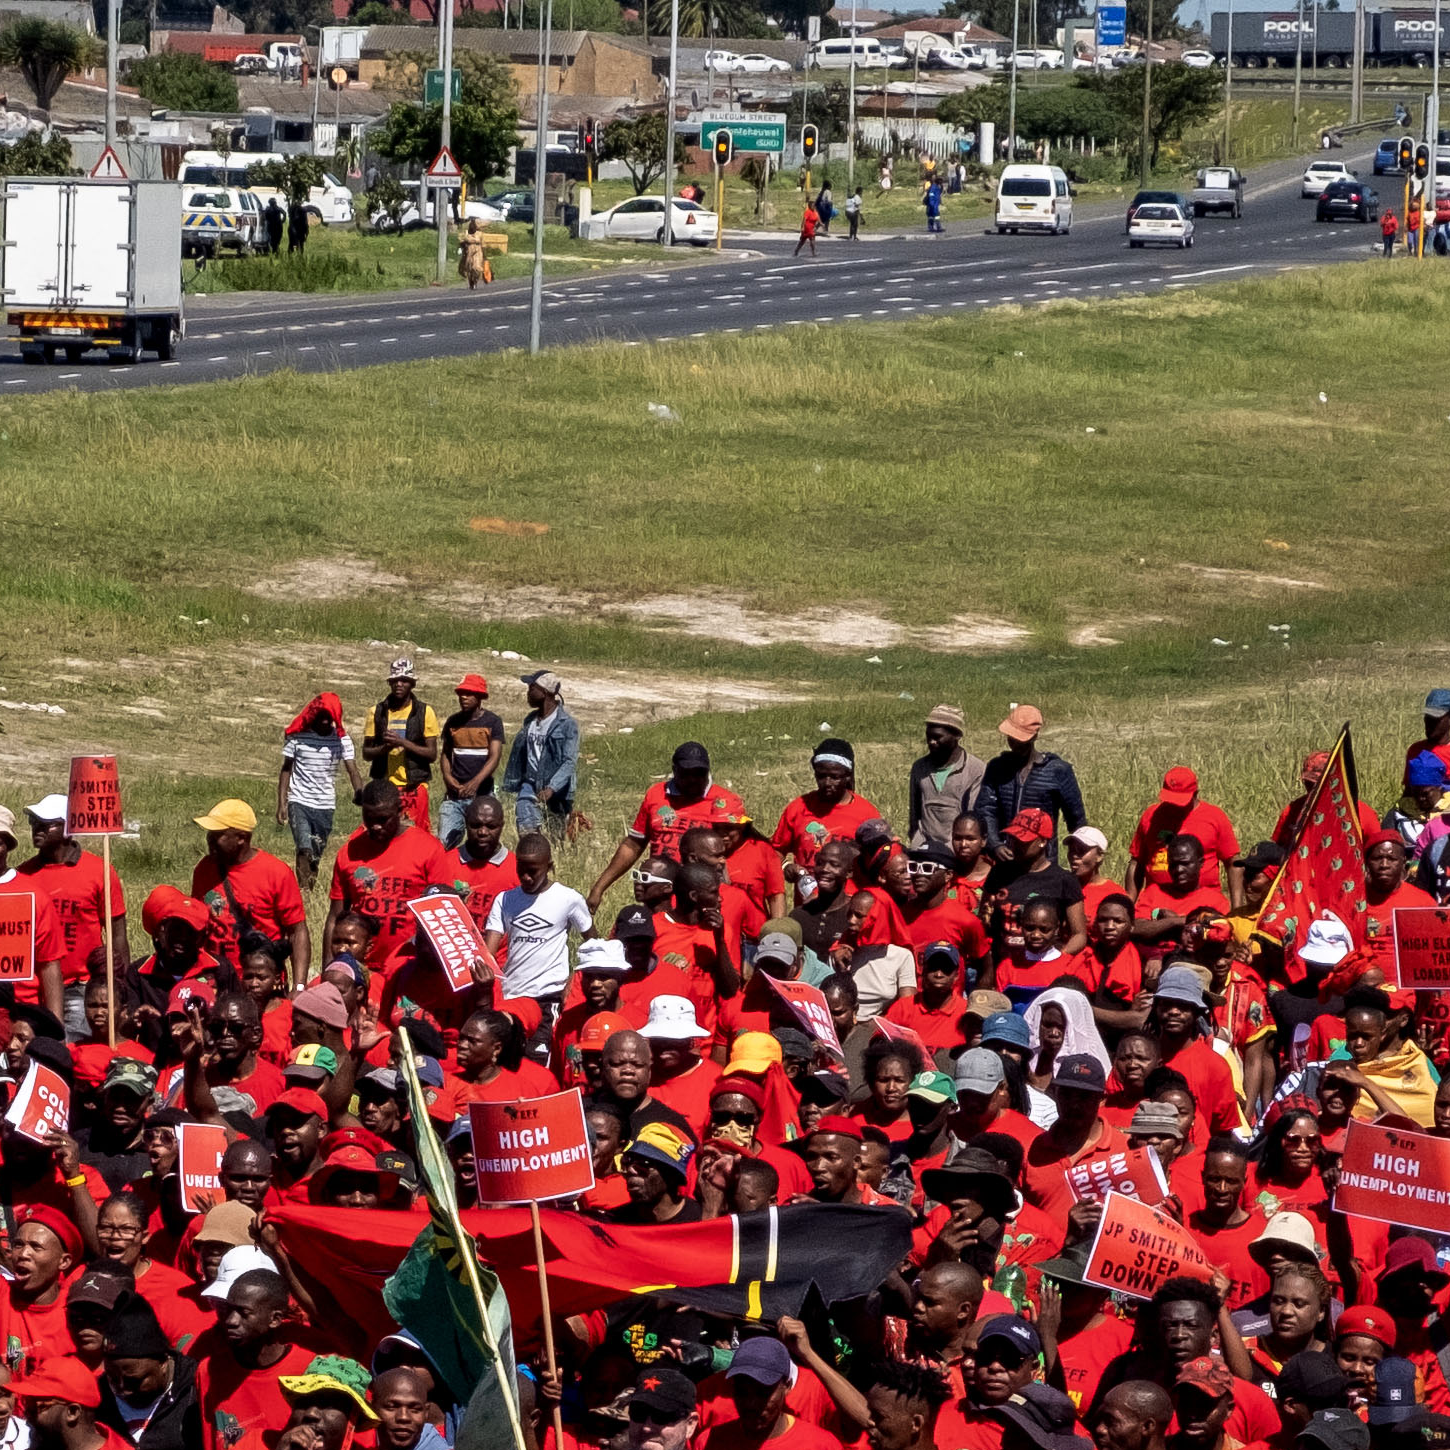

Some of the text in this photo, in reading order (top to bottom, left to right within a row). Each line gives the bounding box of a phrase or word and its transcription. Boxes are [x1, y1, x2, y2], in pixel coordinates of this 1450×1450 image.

[1263, 21, 1314, 32] POOL
[749, 114, 777, 122] STREET
[87, 796, 117, 811] STEP
[72, 812, 108, 829] DOWN
[420, 911, 466, 978] MATERIAL
[1401, 938, 1427, 951] HIGH
[519, 1108, 538, 1118] EFF
[498, 1126, 550, 1150] HIGH
[1399, 1139, 1417, 1151] EFF
[479, 1145, 589, 1173] UNEMPLOYMENT
[1373, 1152, 1420, 1178] HIGH
[1104, 1224, 1179, 1256] JP SMITH
[1133, 1250, 1180, 1277] STEP
[1099, 1261, 1159, 1294] DOWN
